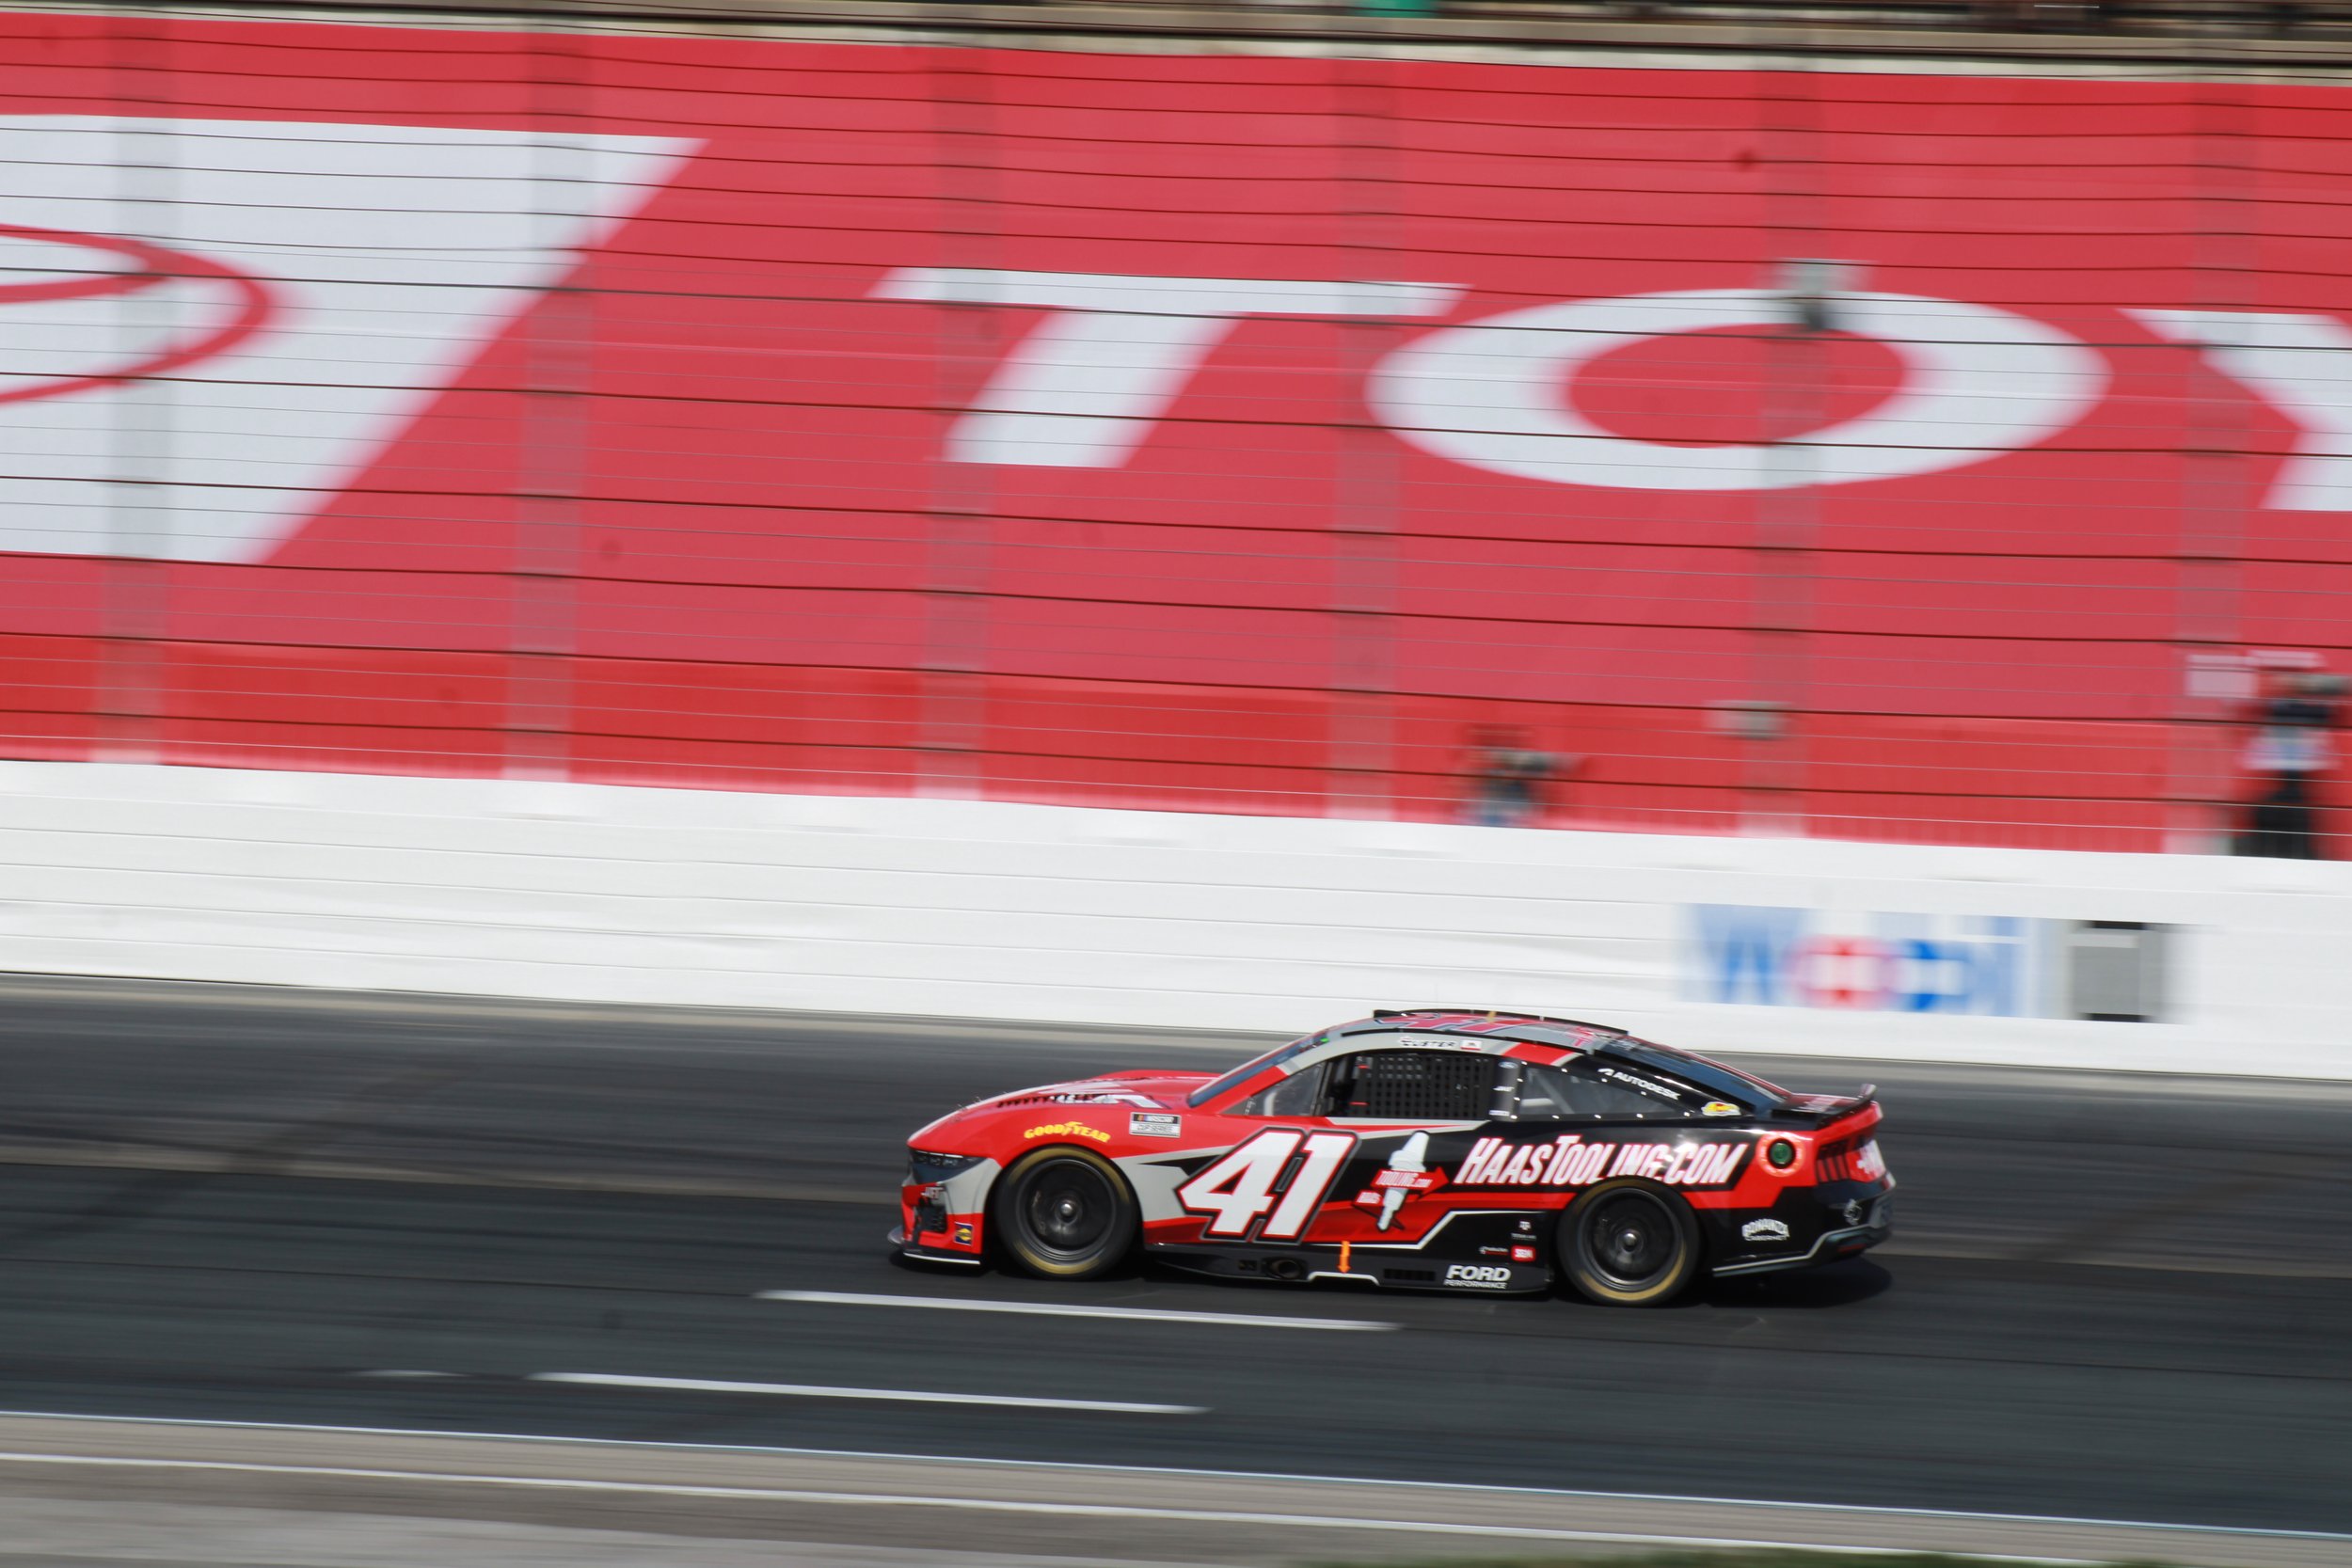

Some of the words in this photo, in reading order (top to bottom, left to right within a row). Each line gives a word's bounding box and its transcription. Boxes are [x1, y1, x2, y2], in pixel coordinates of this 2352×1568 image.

[1613, 1072, 1681, 1101] AUTODESK
[1024, 1121, 1111, 1143] GOODYEAR
[1176, 1129, 1358, 1242] 41
[1446, 1264, 1511, 1281] FORD
